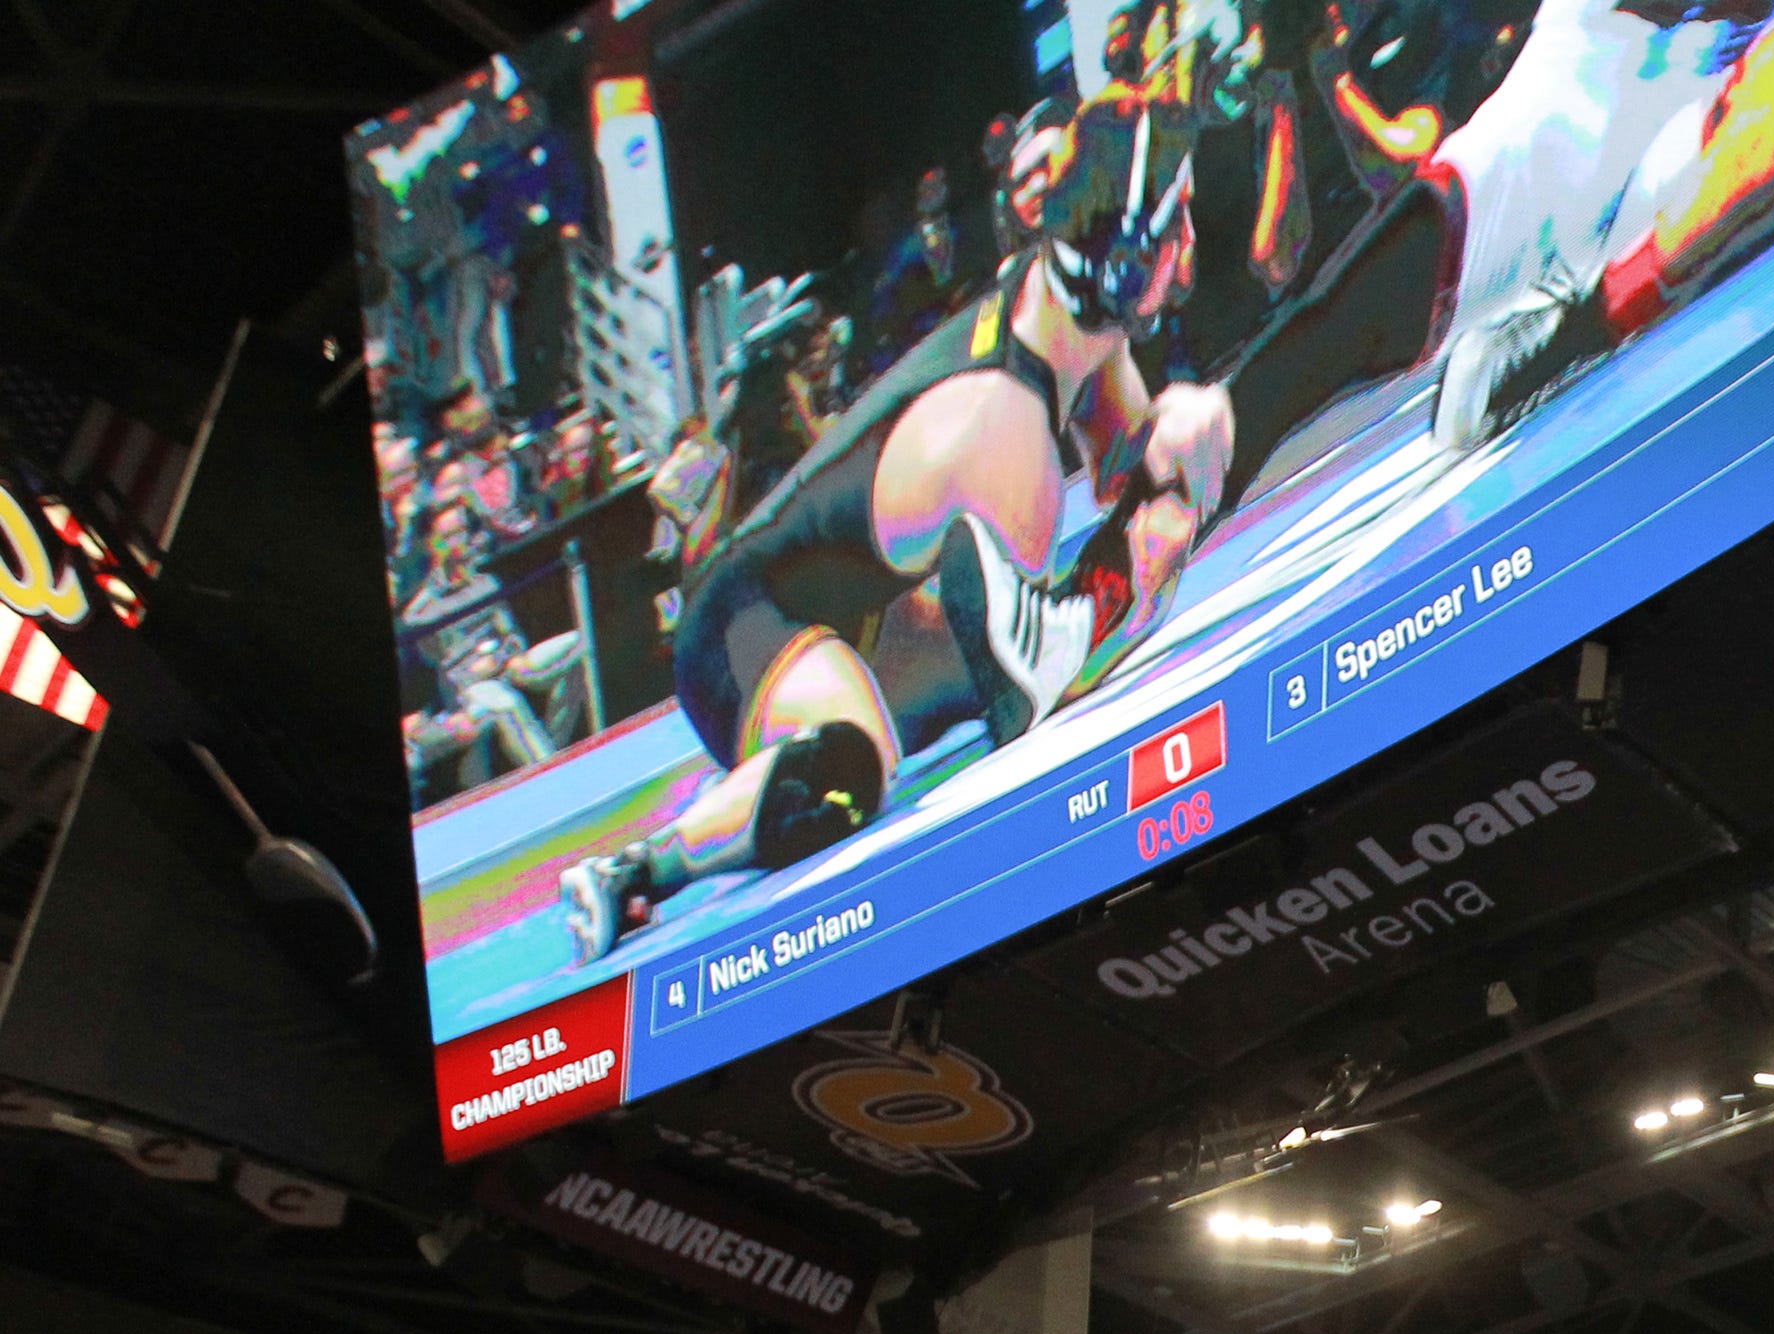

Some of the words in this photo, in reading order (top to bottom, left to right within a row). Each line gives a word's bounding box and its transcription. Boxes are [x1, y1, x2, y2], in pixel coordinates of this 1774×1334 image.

[1285, 674, 1307, 709] 3
[1334, 580, 1467, 684] Spencer
[1471, 545, 1534, 604] Lee
[1066, 780, 1110, 824] RUT
[1162, 731, 1192, 785] 0
[1137, 789, 1215, 862] 0:08
[1098, 866, 1374, 1000] Quicken
[1356, 758, 1598, 885] Loans
[668, 980, 687, 1009] 4
[708, 945, 769, 995] Nick
[772, 899, 876, 968] Suriano
[1300, 879, 1497, 974] Arena
[450, 1048, 617, 1131] CHAMPIONSHIP
[490, 1038, 532, 1076] 125
[532, 1026, 568, 1062] LB.
[545, 1171, 854, 1315] NCAAWRESTLING
